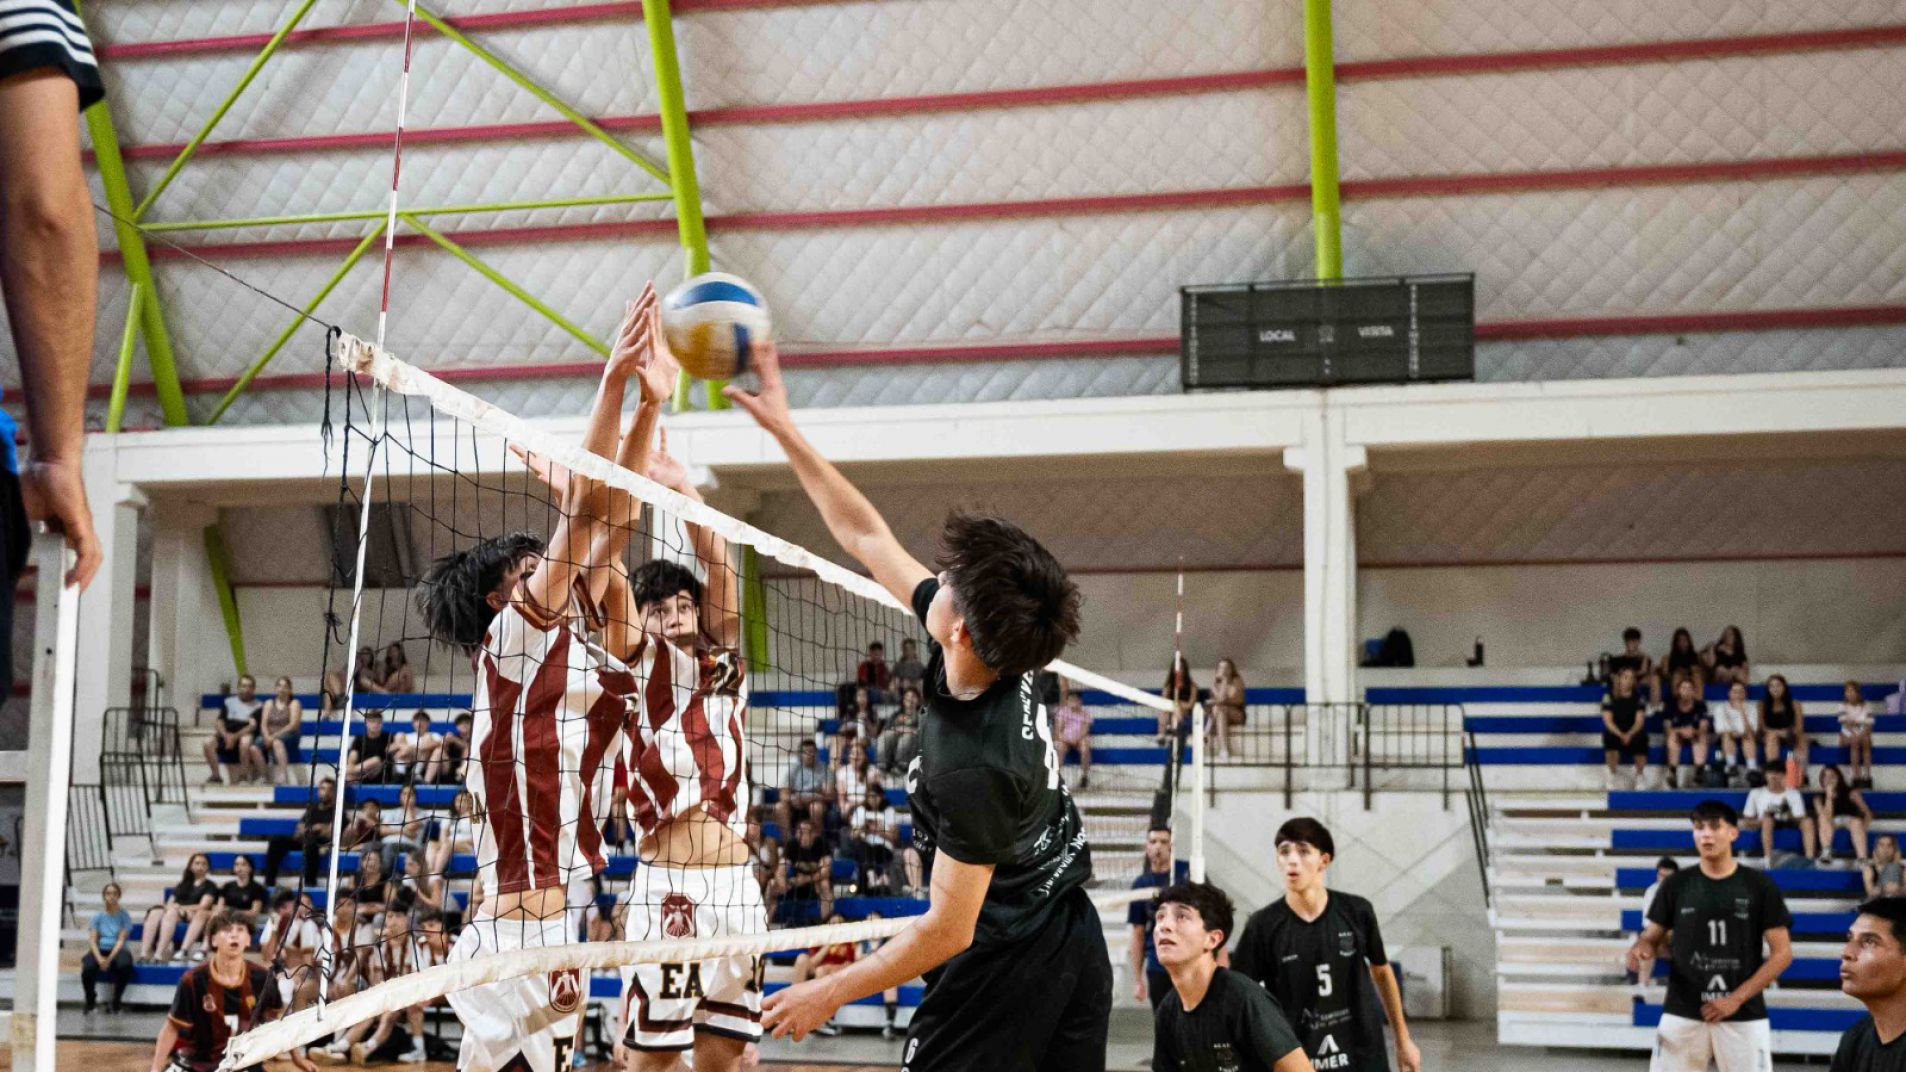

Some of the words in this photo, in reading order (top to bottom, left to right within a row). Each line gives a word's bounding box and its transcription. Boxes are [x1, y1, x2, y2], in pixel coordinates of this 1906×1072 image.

[1259, 329, 1296, 342] LOCAL
[1707, 919, 1727, 946] 11
[1316, 963, 1333, 997] 5
